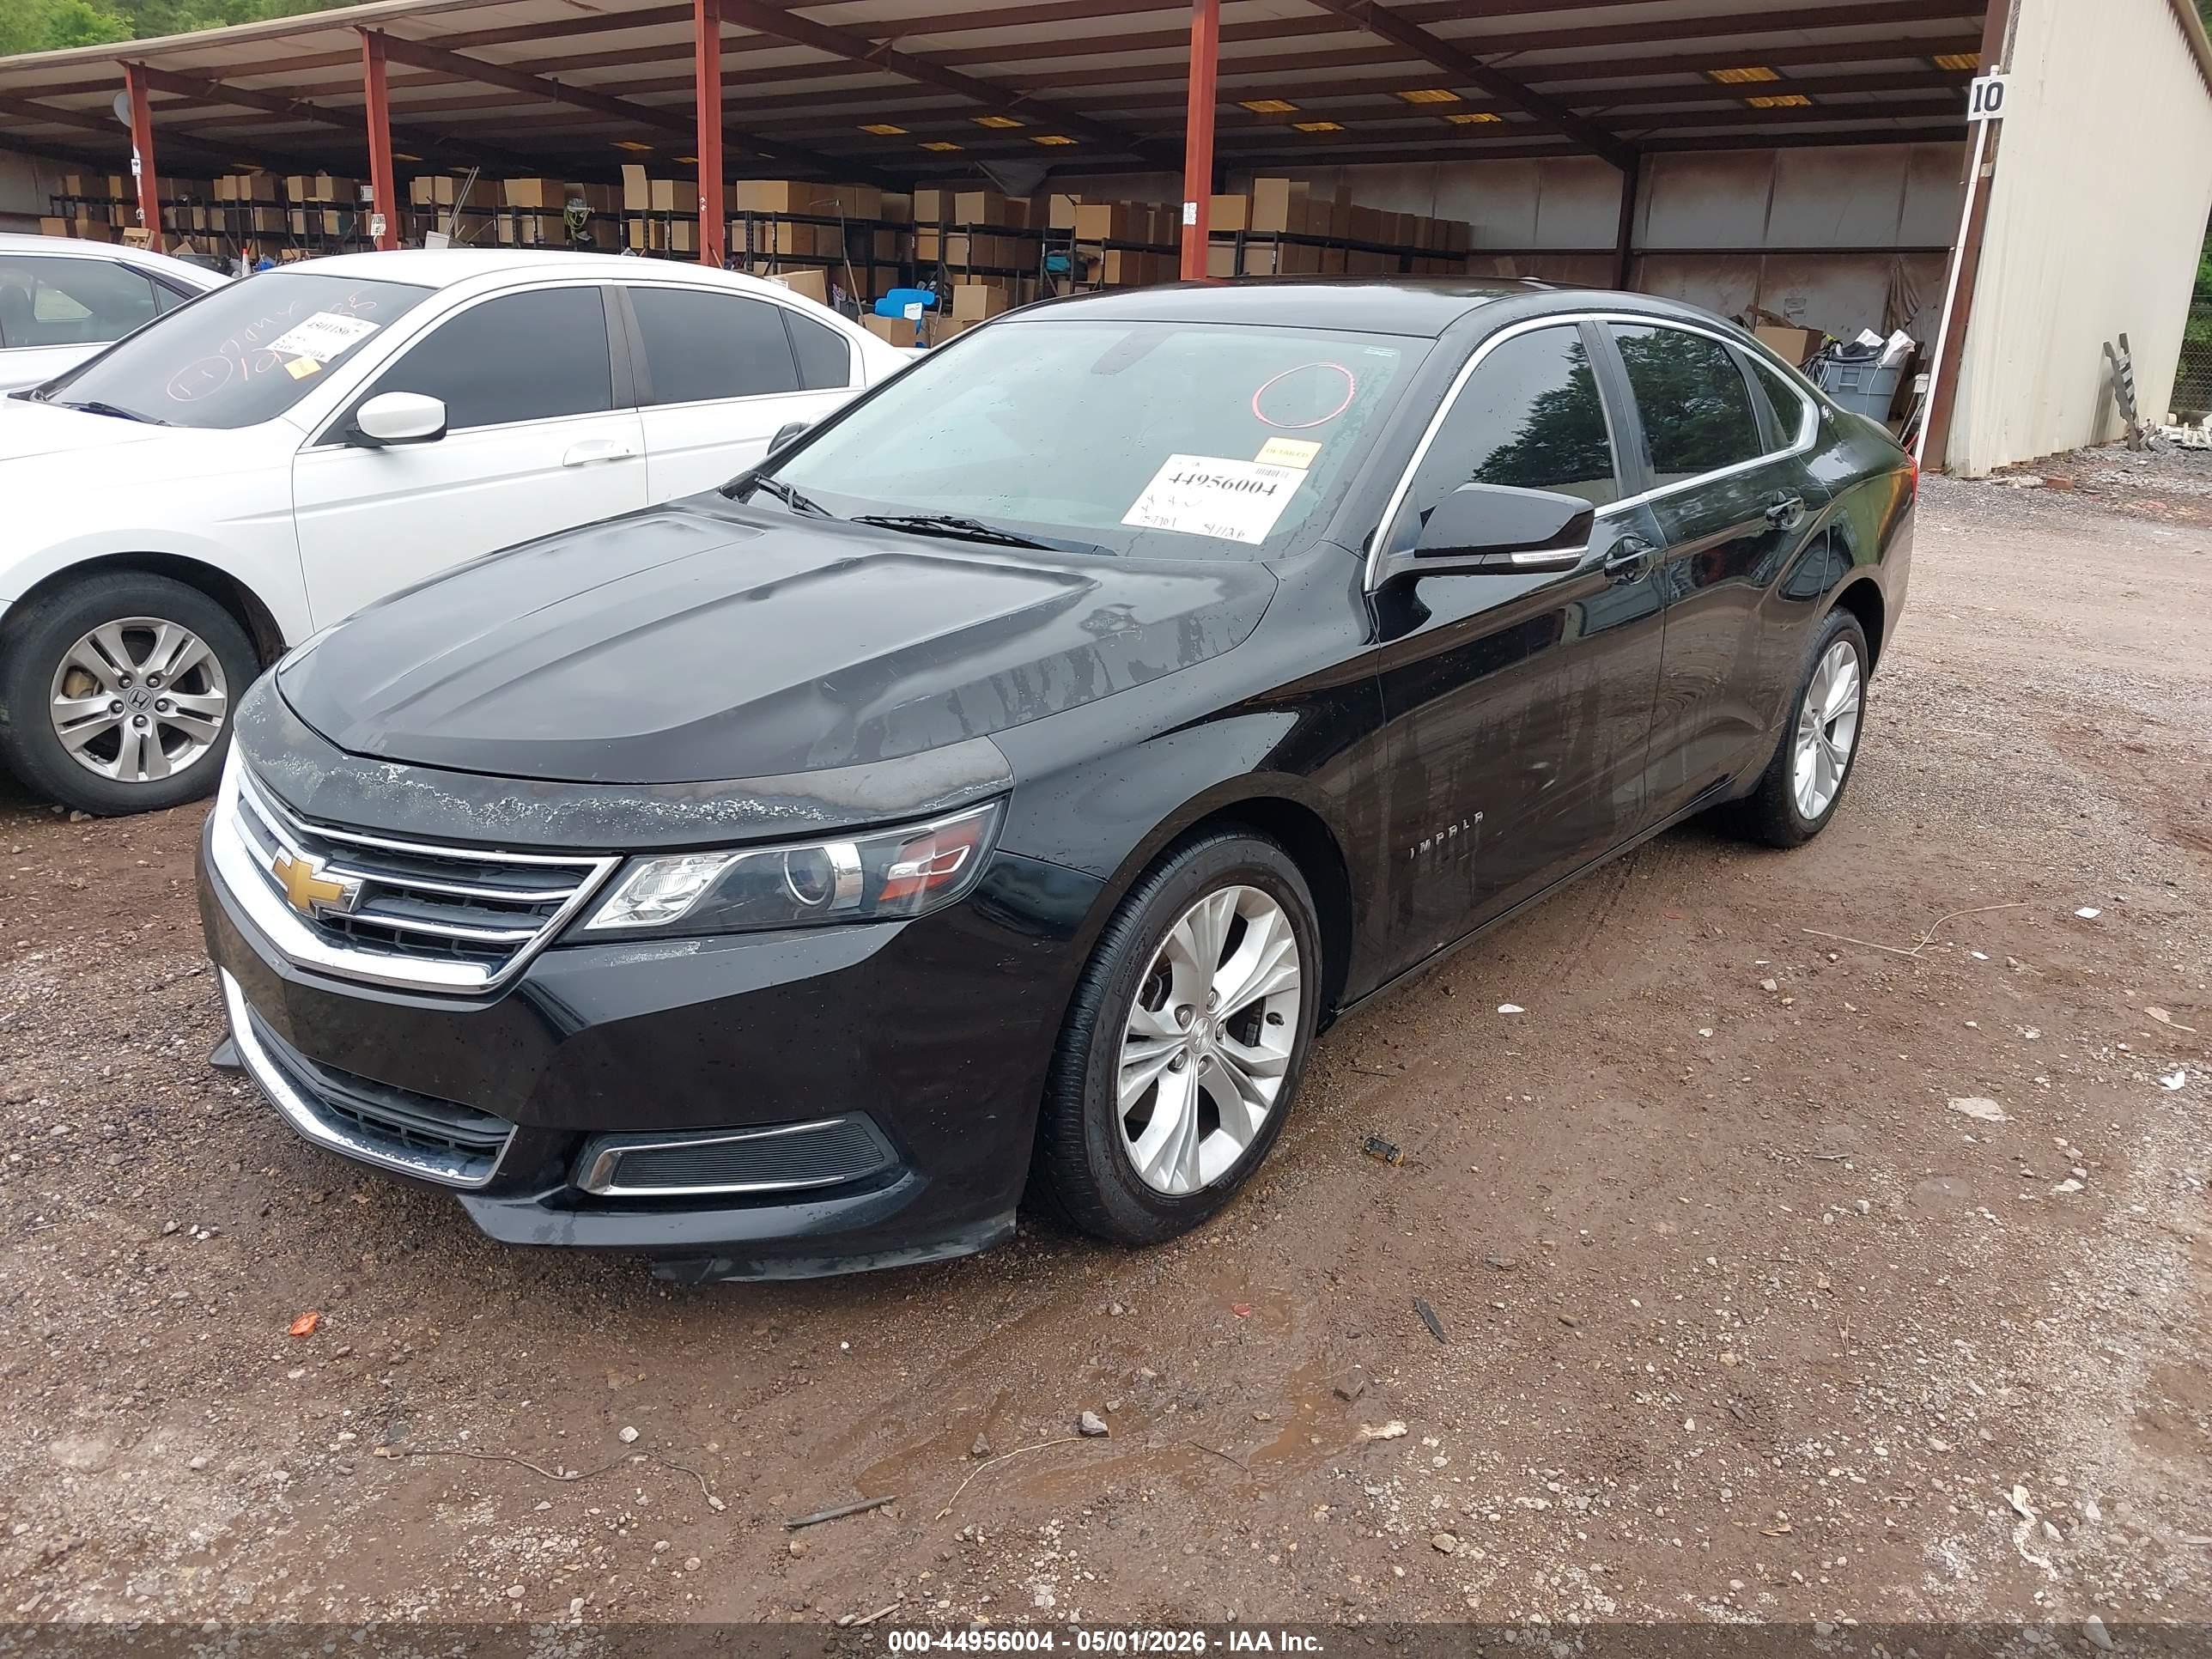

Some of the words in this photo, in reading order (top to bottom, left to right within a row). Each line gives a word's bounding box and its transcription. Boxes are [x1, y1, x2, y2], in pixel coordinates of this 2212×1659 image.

[1972, 82, 2004, 112] 10
[1169, 472, 1278, 496] 44956004
[1408, 811, 1485, 860] IMPALA
